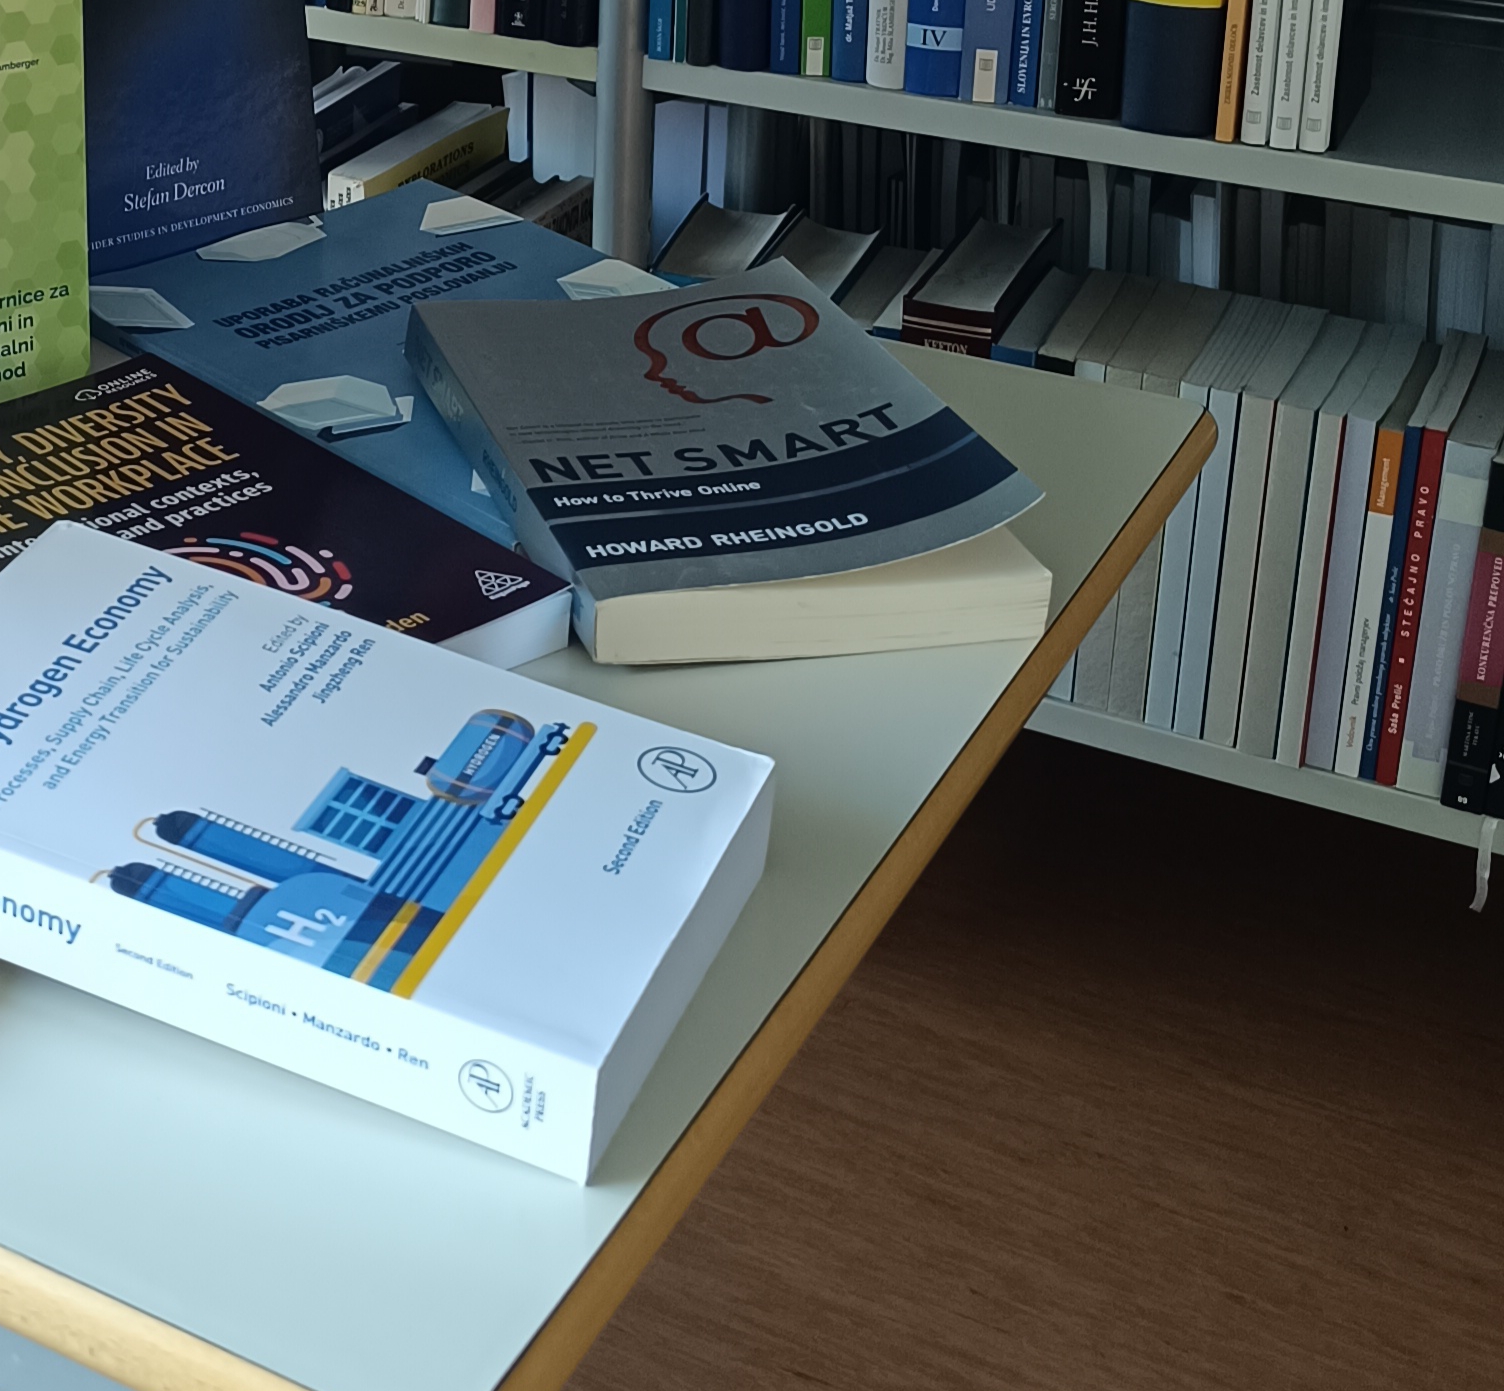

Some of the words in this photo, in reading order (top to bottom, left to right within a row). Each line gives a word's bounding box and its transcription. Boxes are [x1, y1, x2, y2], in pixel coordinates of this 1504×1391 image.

[920, 29, 947, 46] IV
[124, 183, 169, 213] Stefan
[174, 176, 225, 202] Dercon
[18, 312, 35, 328] in
[49, 283, 70, 300] za
[12, 384, 192, 455] DIVERSITY
[158, 412, 214, 442] IN
[529, 451, 651, 483] NET
[682, 402, 897, 474] SMART
[14, 437, 240, 520] WORKPLACE
[553, 493, 597, 508] How
[602, 490, 623, 504] to
[626, 485, 692, 503] Thrive
[697, 479, 761, 496] Online
[586, 536, 702, 558] HOWARD
[711, 512, 868, 546] RHEINGOLD
[1401, 553, 1421, 638] STEČAJNO
[1414, 486, 1429, 539] PRAVO
[62, 564, 173, 654] Economy
[603, 836, 640, 875] Second
[628, 799, 663, 837] Edition
[226, 983, 286, 1017] Scipioni
[303, 1012, 380, 1051] Manzardo
[398, 1048, 429, 1071] Ren
